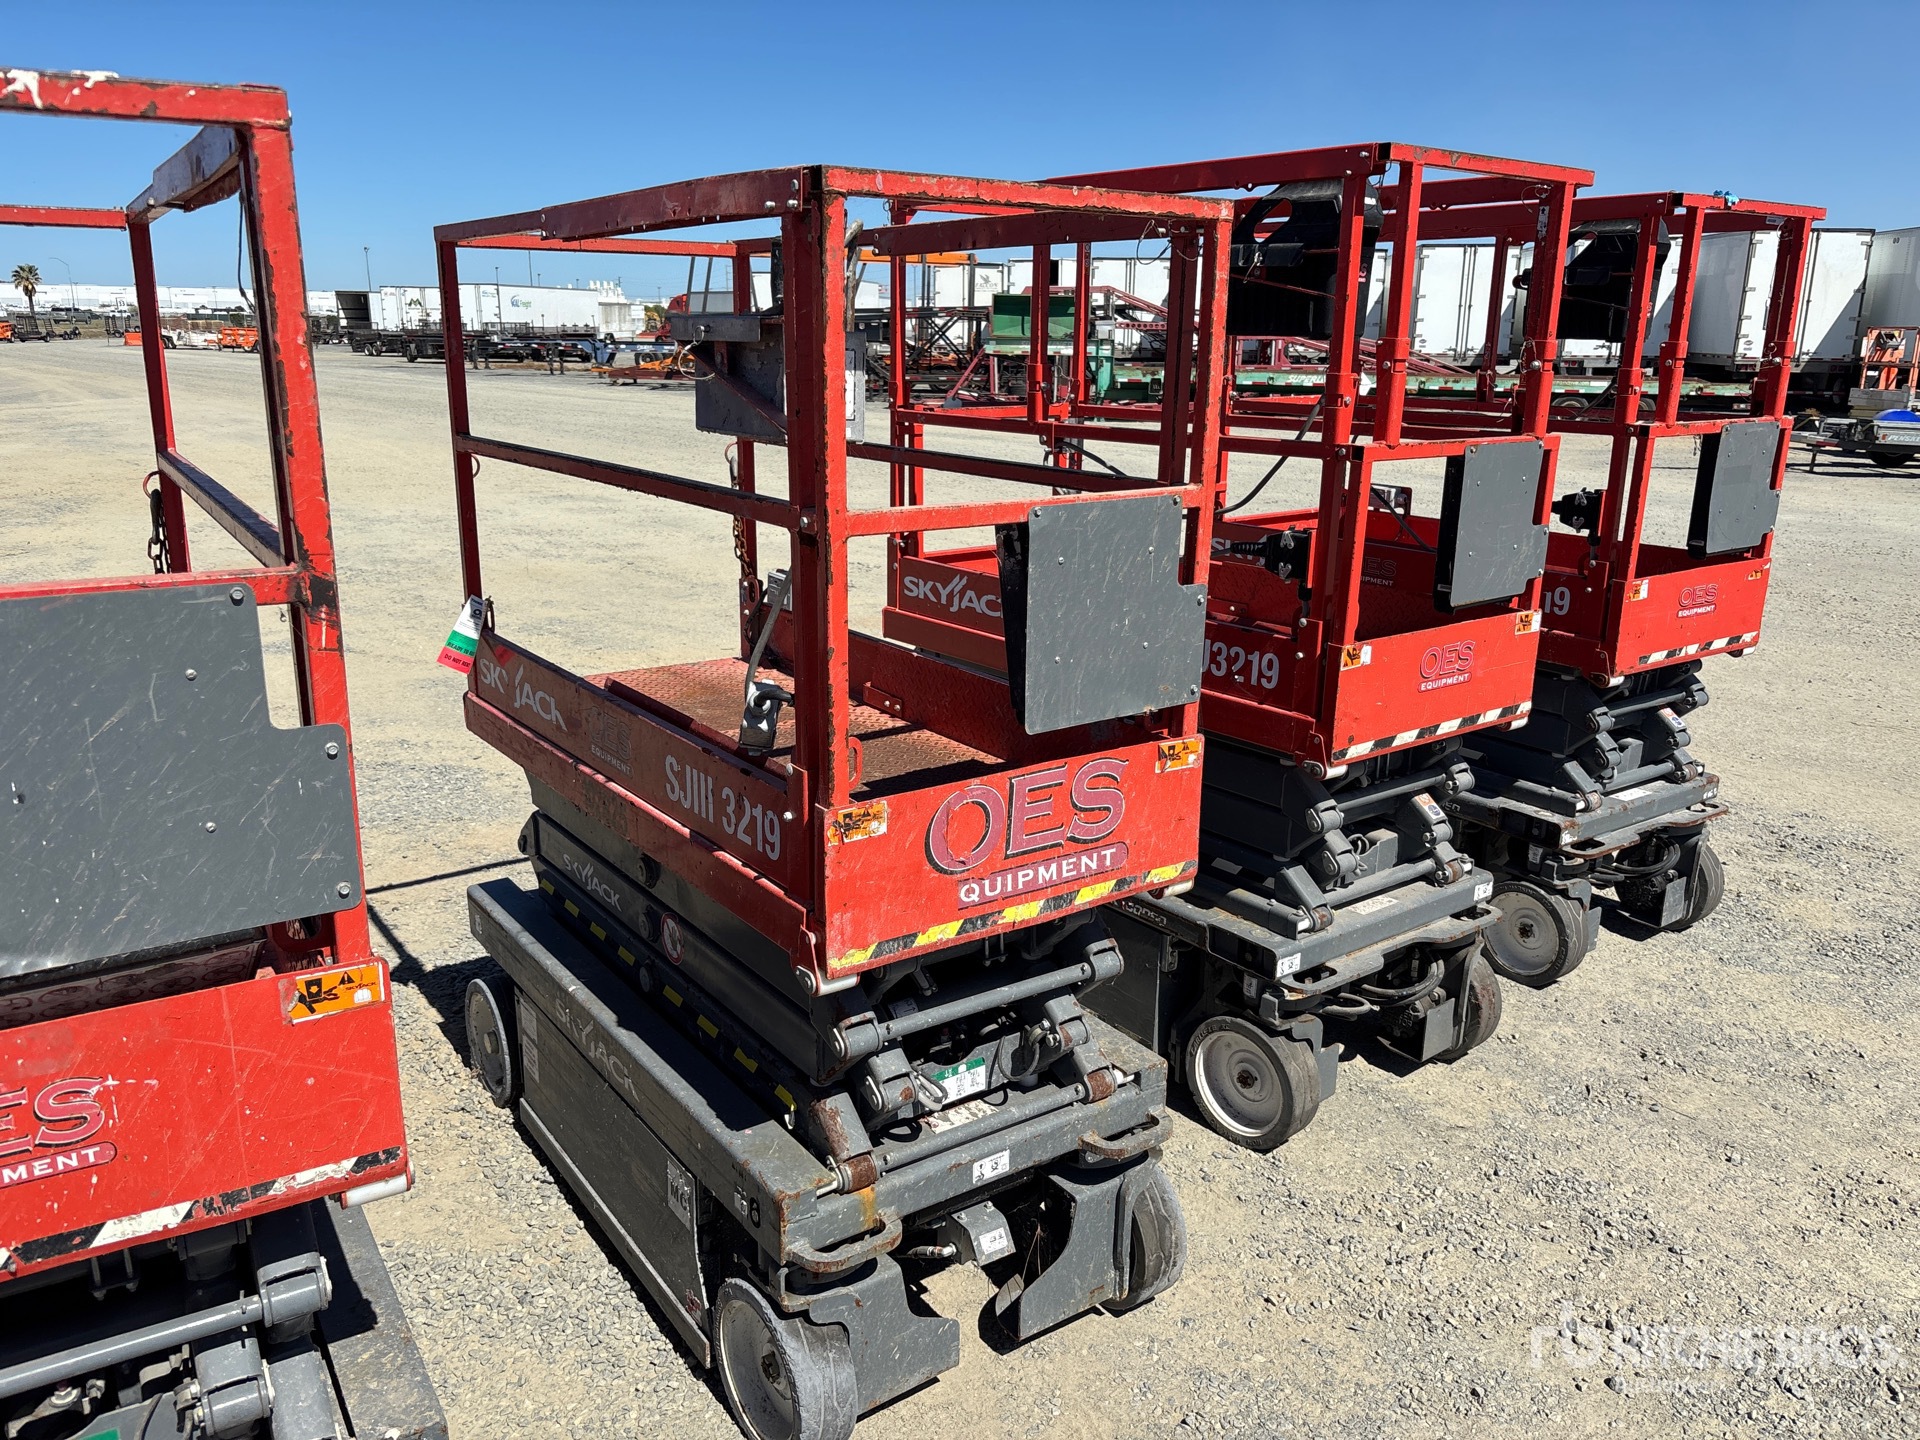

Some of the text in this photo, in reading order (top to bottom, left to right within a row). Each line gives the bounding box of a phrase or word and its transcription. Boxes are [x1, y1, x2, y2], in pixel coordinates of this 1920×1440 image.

[1364, 556, 1397, 577] ES
[903, 574, 1003, 618] SKYJAC
[1543, 586, 1571, 616] 19
[1678, 583, 1718, 607] OES
[1678, 604, 1715, 618] EQUIPMENT
[1420, 640, 1475, 679] OES
[1420, 673, 1470, 691] EQUIPMENT
[591, 744, 632, 776] EQUIPMENT
[721, 786, 780, 861] 3219
[925, 757, 1129, 876] OES
[2, 1146, 101, 1184] MENT
